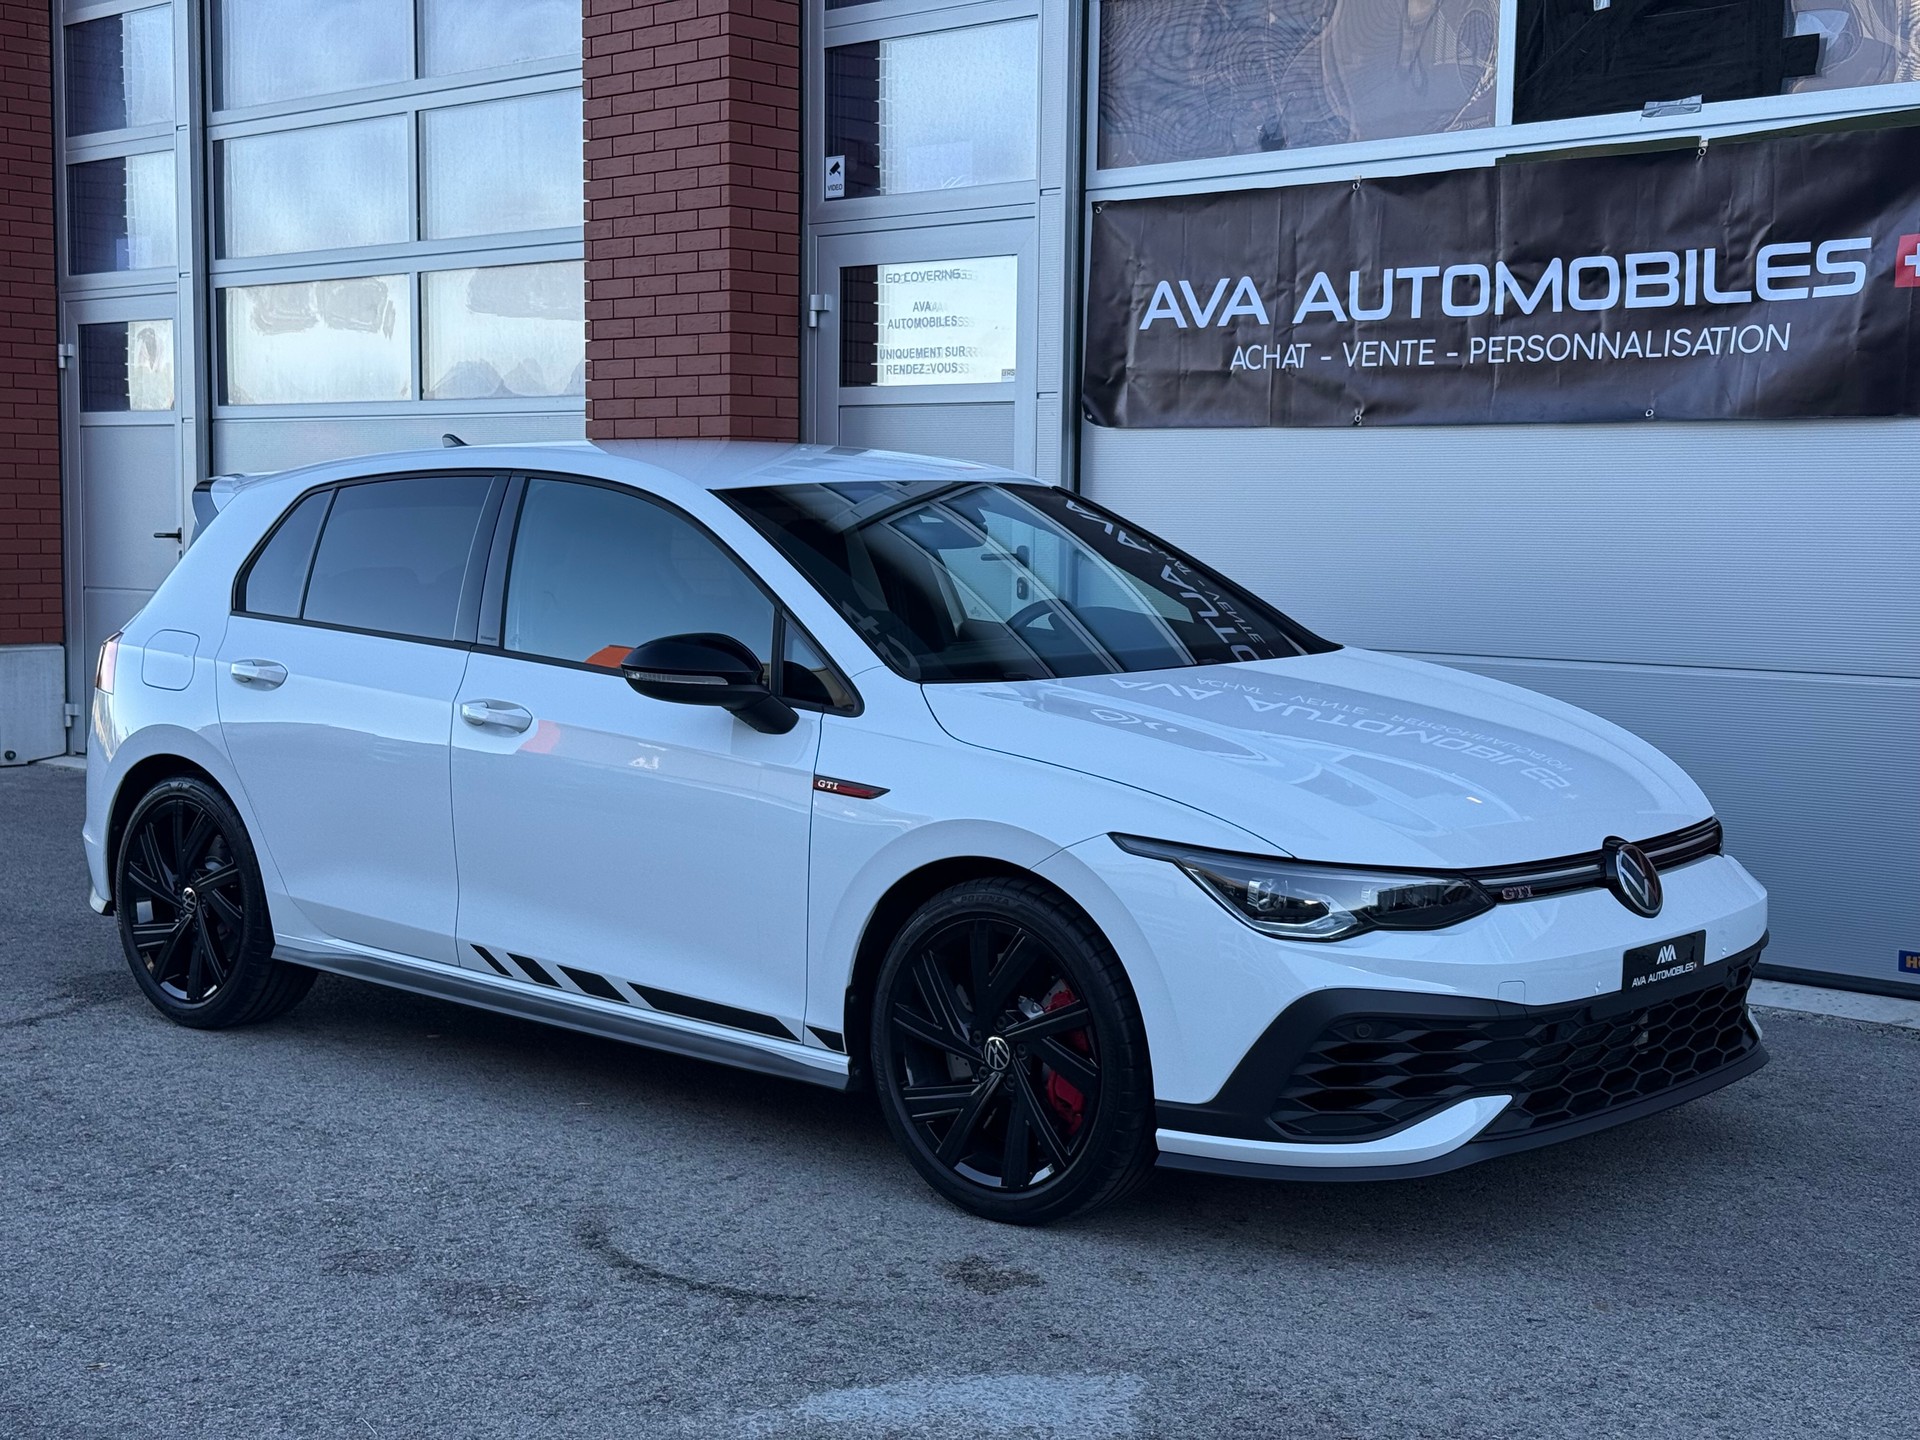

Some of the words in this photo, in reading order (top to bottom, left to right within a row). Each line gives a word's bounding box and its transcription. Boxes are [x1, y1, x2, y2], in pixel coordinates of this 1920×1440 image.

[904, 269, 961, 283] COVERING
[1139, 276, 1270, 330] AVA
[1292, 237, 1872, 323] AUTOMOBILES
[912, 301, 931, 312] AVA
[887, 316, 958, 330] AUTOMOBILES
[879, 346, 942, 360] UNIQUEMENT
[945, 346, 966, 357] SUR
[1230, 343, 1311, 371] ACHAT
[1342, 339, 1437, 367] VENTE
[1469, 323, 1791, 364] PERSONNALISATION
[886, 362, 958, 375] RENDEZ-VOUS
[817, 780, 839, 790] GTI
[1501, 885, 1533, 900] GTI
[1631, 976, 1646, 988] AVA
[1647, 961, 1694, 984] AUTOMOBILES
